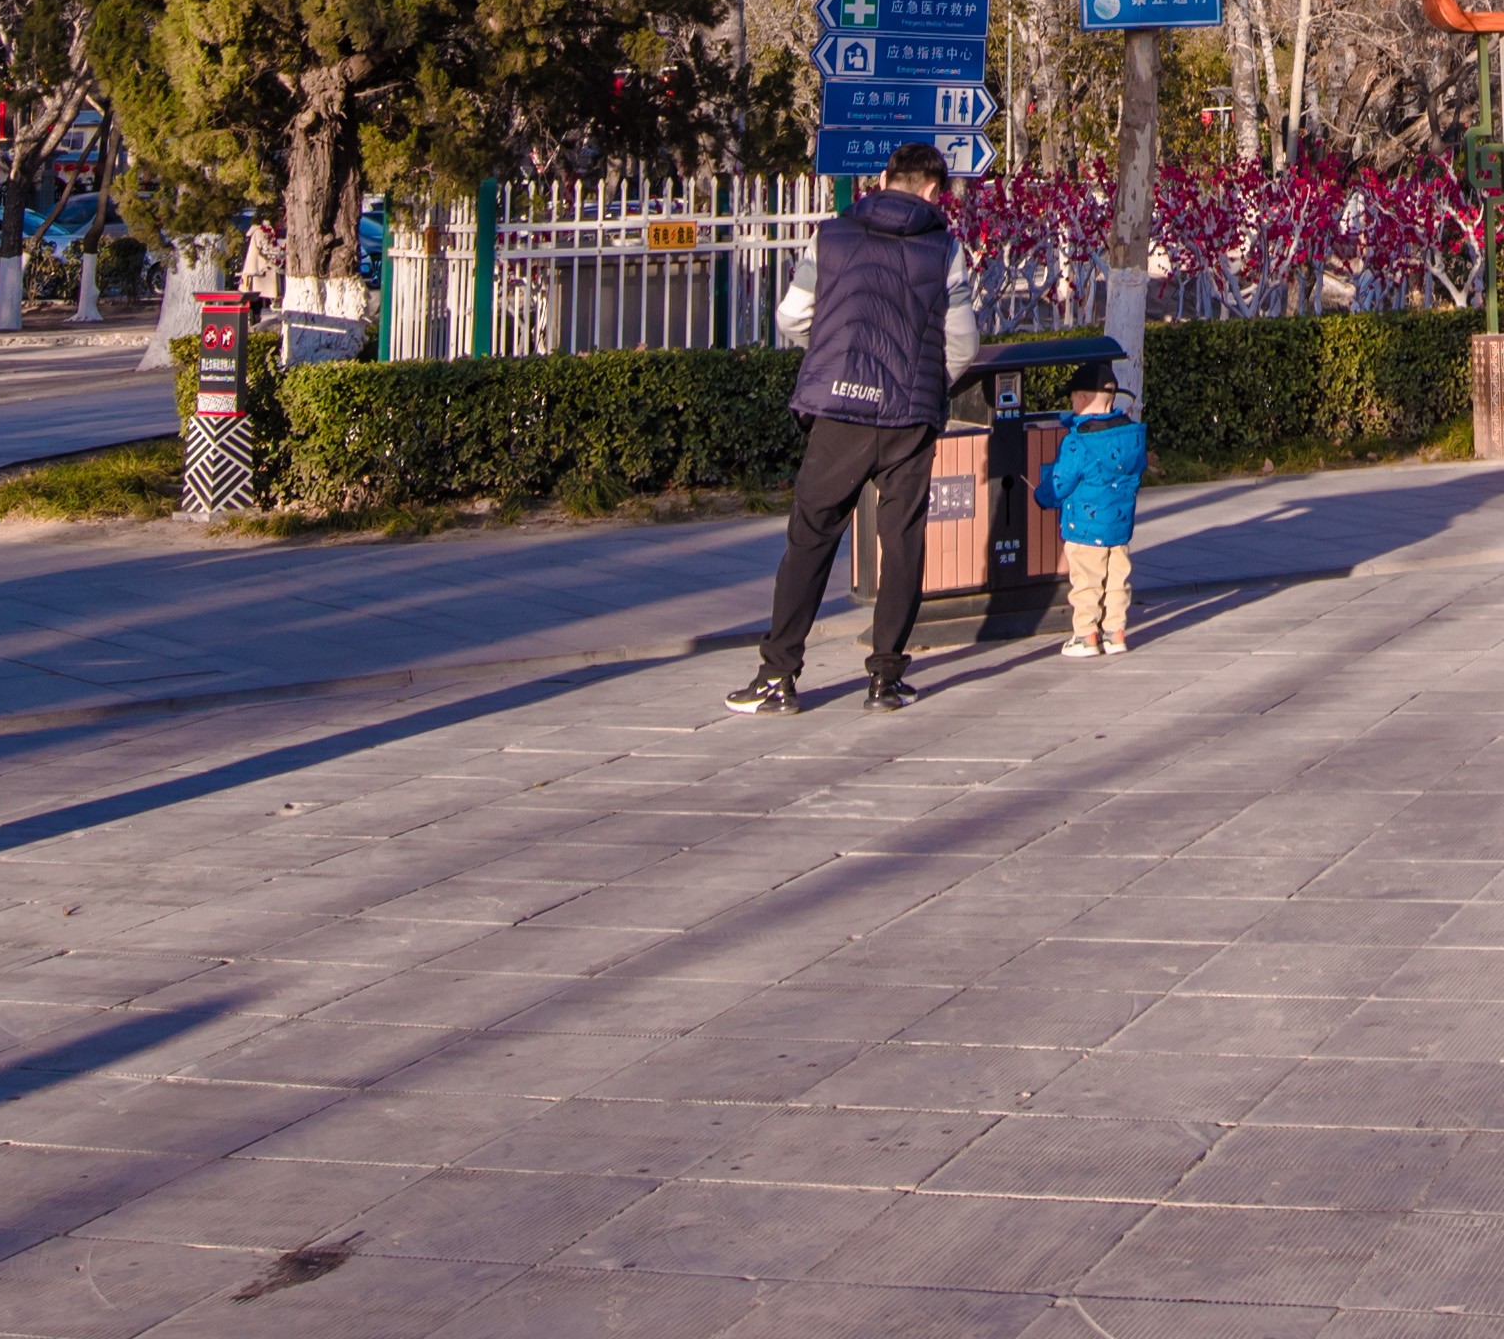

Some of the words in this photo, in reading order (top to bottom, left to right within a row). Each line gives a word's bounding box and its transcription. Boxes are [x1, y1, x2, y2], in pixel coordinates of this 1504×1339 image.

[891, 0, 977, 17] 应急医疗救护
[887, 44, 973, 61] 应急指挥中心
[852, 91, 911, 107] 应急厕所
[831, 380, 882, 403] LEISURE
